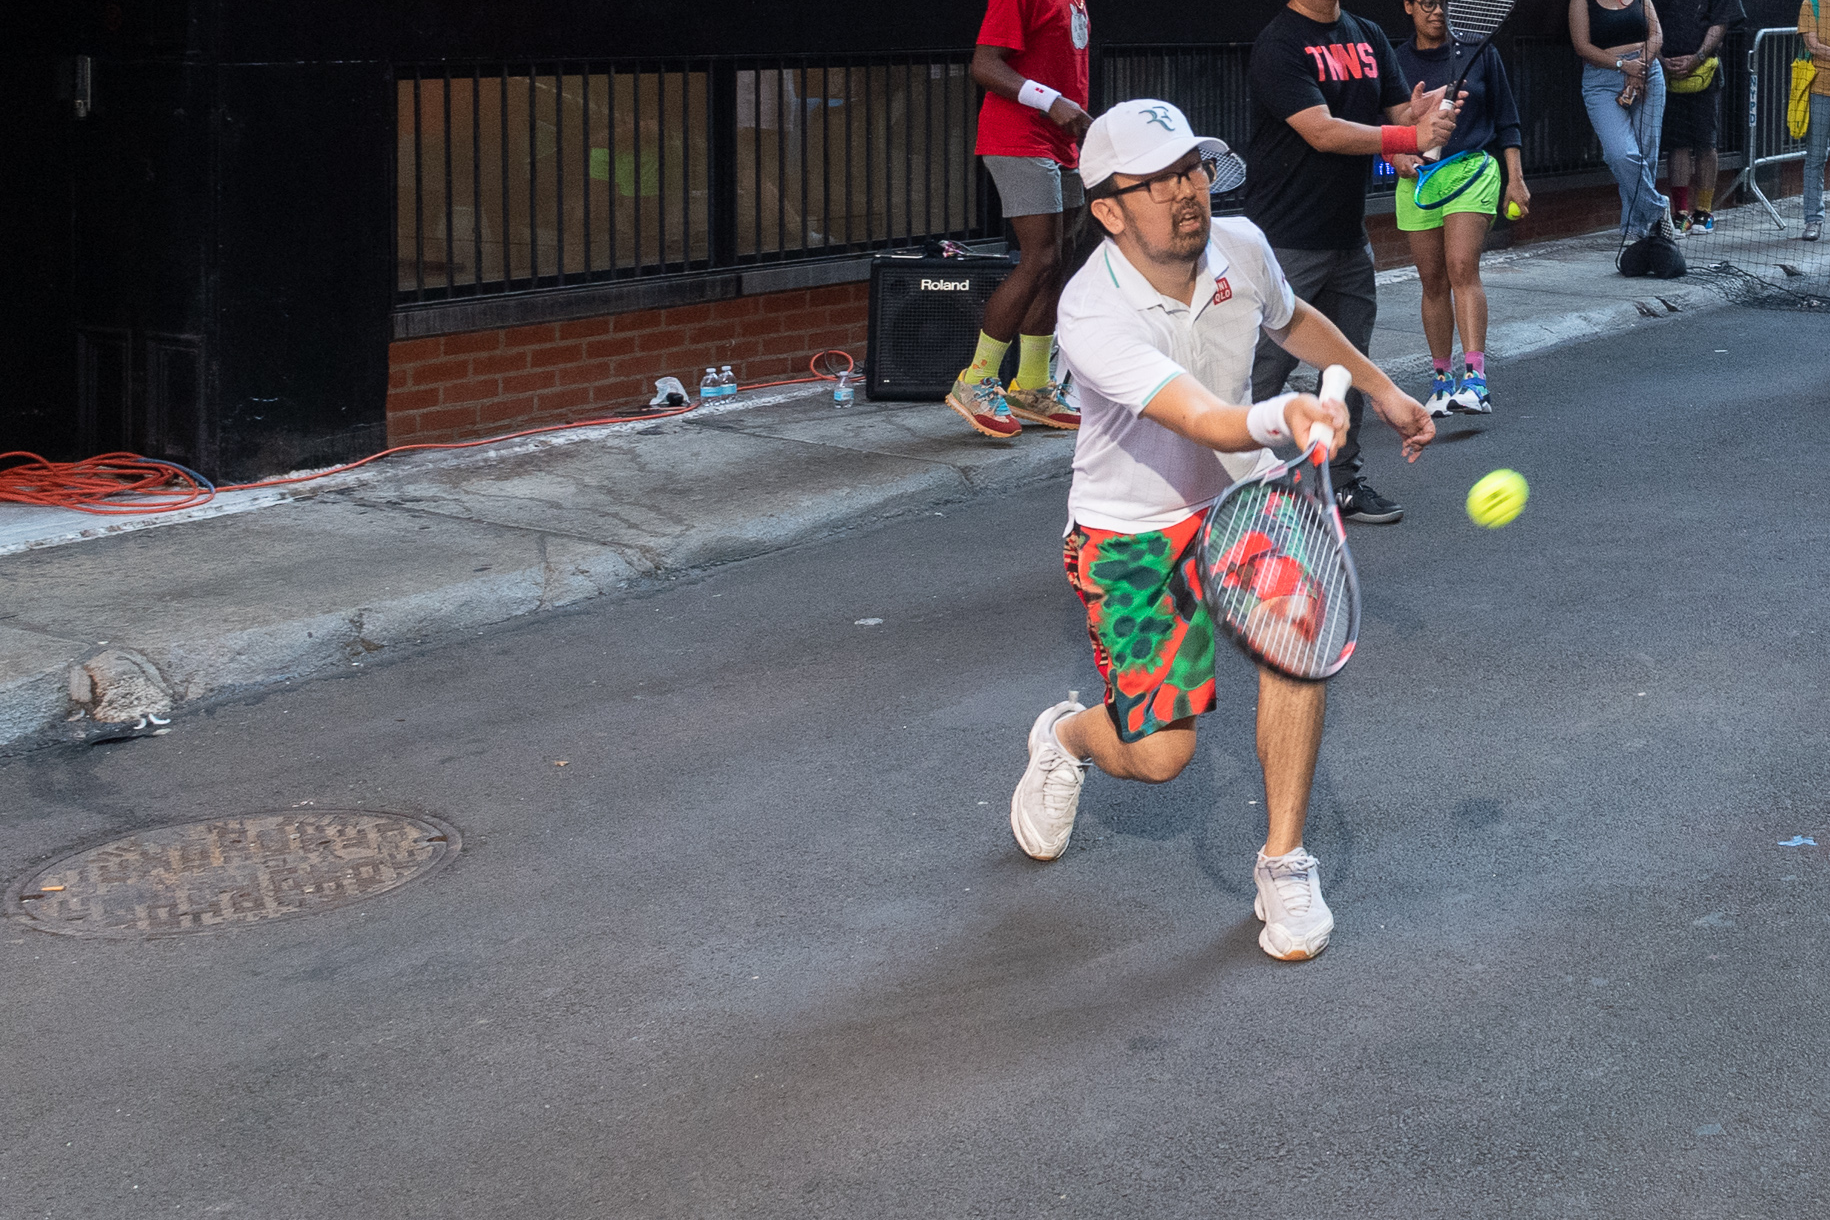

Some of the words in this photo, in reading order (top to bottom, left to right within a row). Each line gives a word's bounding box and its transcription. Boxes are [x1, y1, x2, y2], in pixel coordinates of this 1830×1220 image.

[1749, 74, 1757, 124] NYPD
[921, 279, 970, 291] Roland
[1214, 289, 1231, 303] QLO
